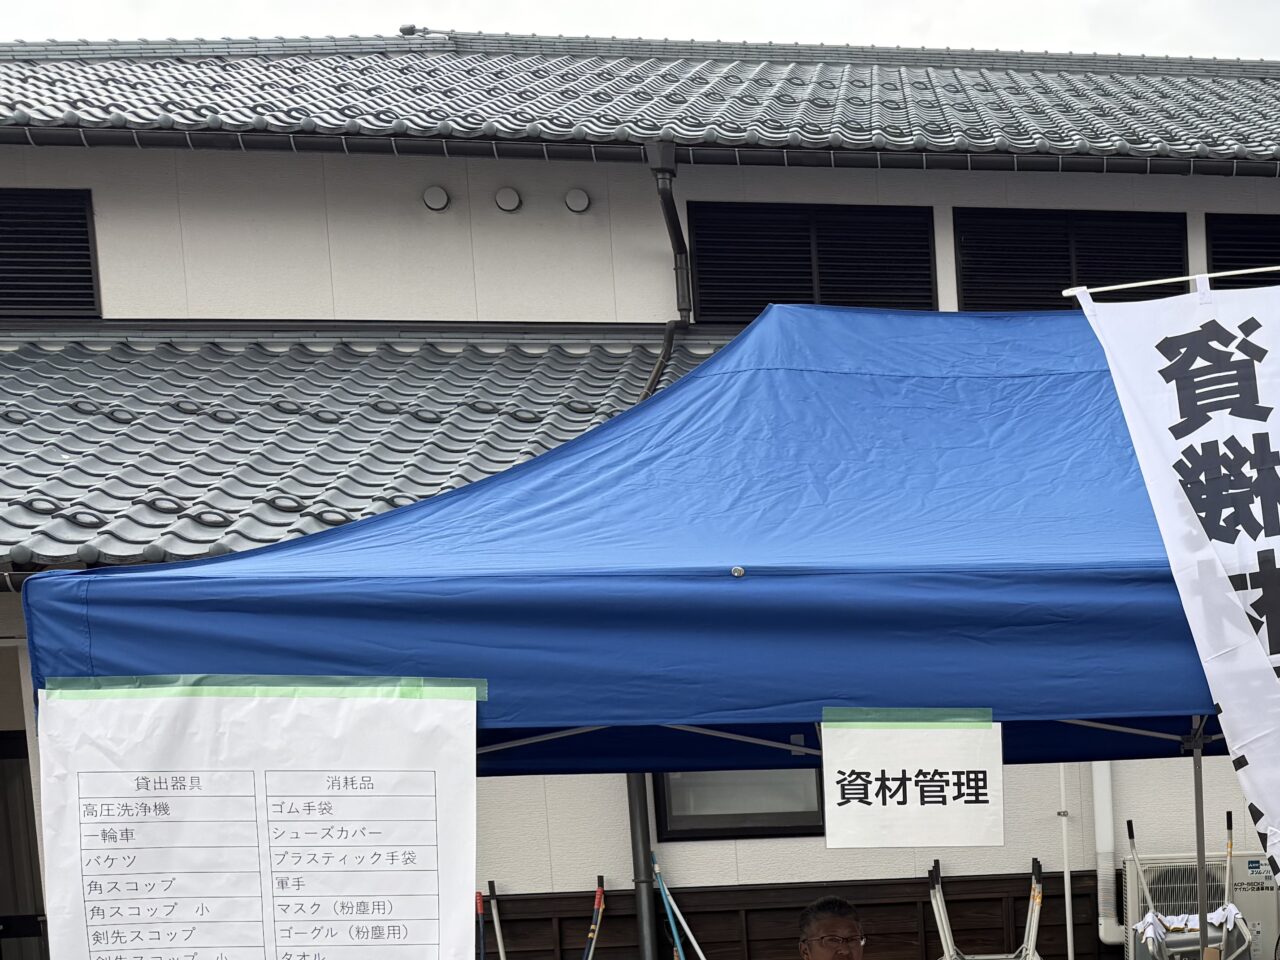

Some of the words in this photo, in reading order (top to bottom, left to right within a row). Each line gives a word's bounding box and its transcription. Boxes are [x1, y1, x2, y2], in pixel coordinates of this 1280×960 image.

[135, 776, 202, 791] 貸出器具
[327, 776, 374, 790] 消耗品
[836, 769, 989, 806] 資材管理
[83, 802, 170, 817] 高圧洗浄機
[272, 801, 333, 815] ゴム手袋
[84, 827, 135, 843] 一輪車
[273, 825, 381, 839] シューズカバー
[86, 855, 136, 868] バケツ
[275, 851, 416, 865] プラスティック手袋
[87, 878, 175, 895] 角スコップ
[276, 877, 305, 890] 軍手
[89, 901, 178, 919] 角スコップ
[196, 903, 209, 916] 小
[90, 926, 196, 945] 剣先スコップ
